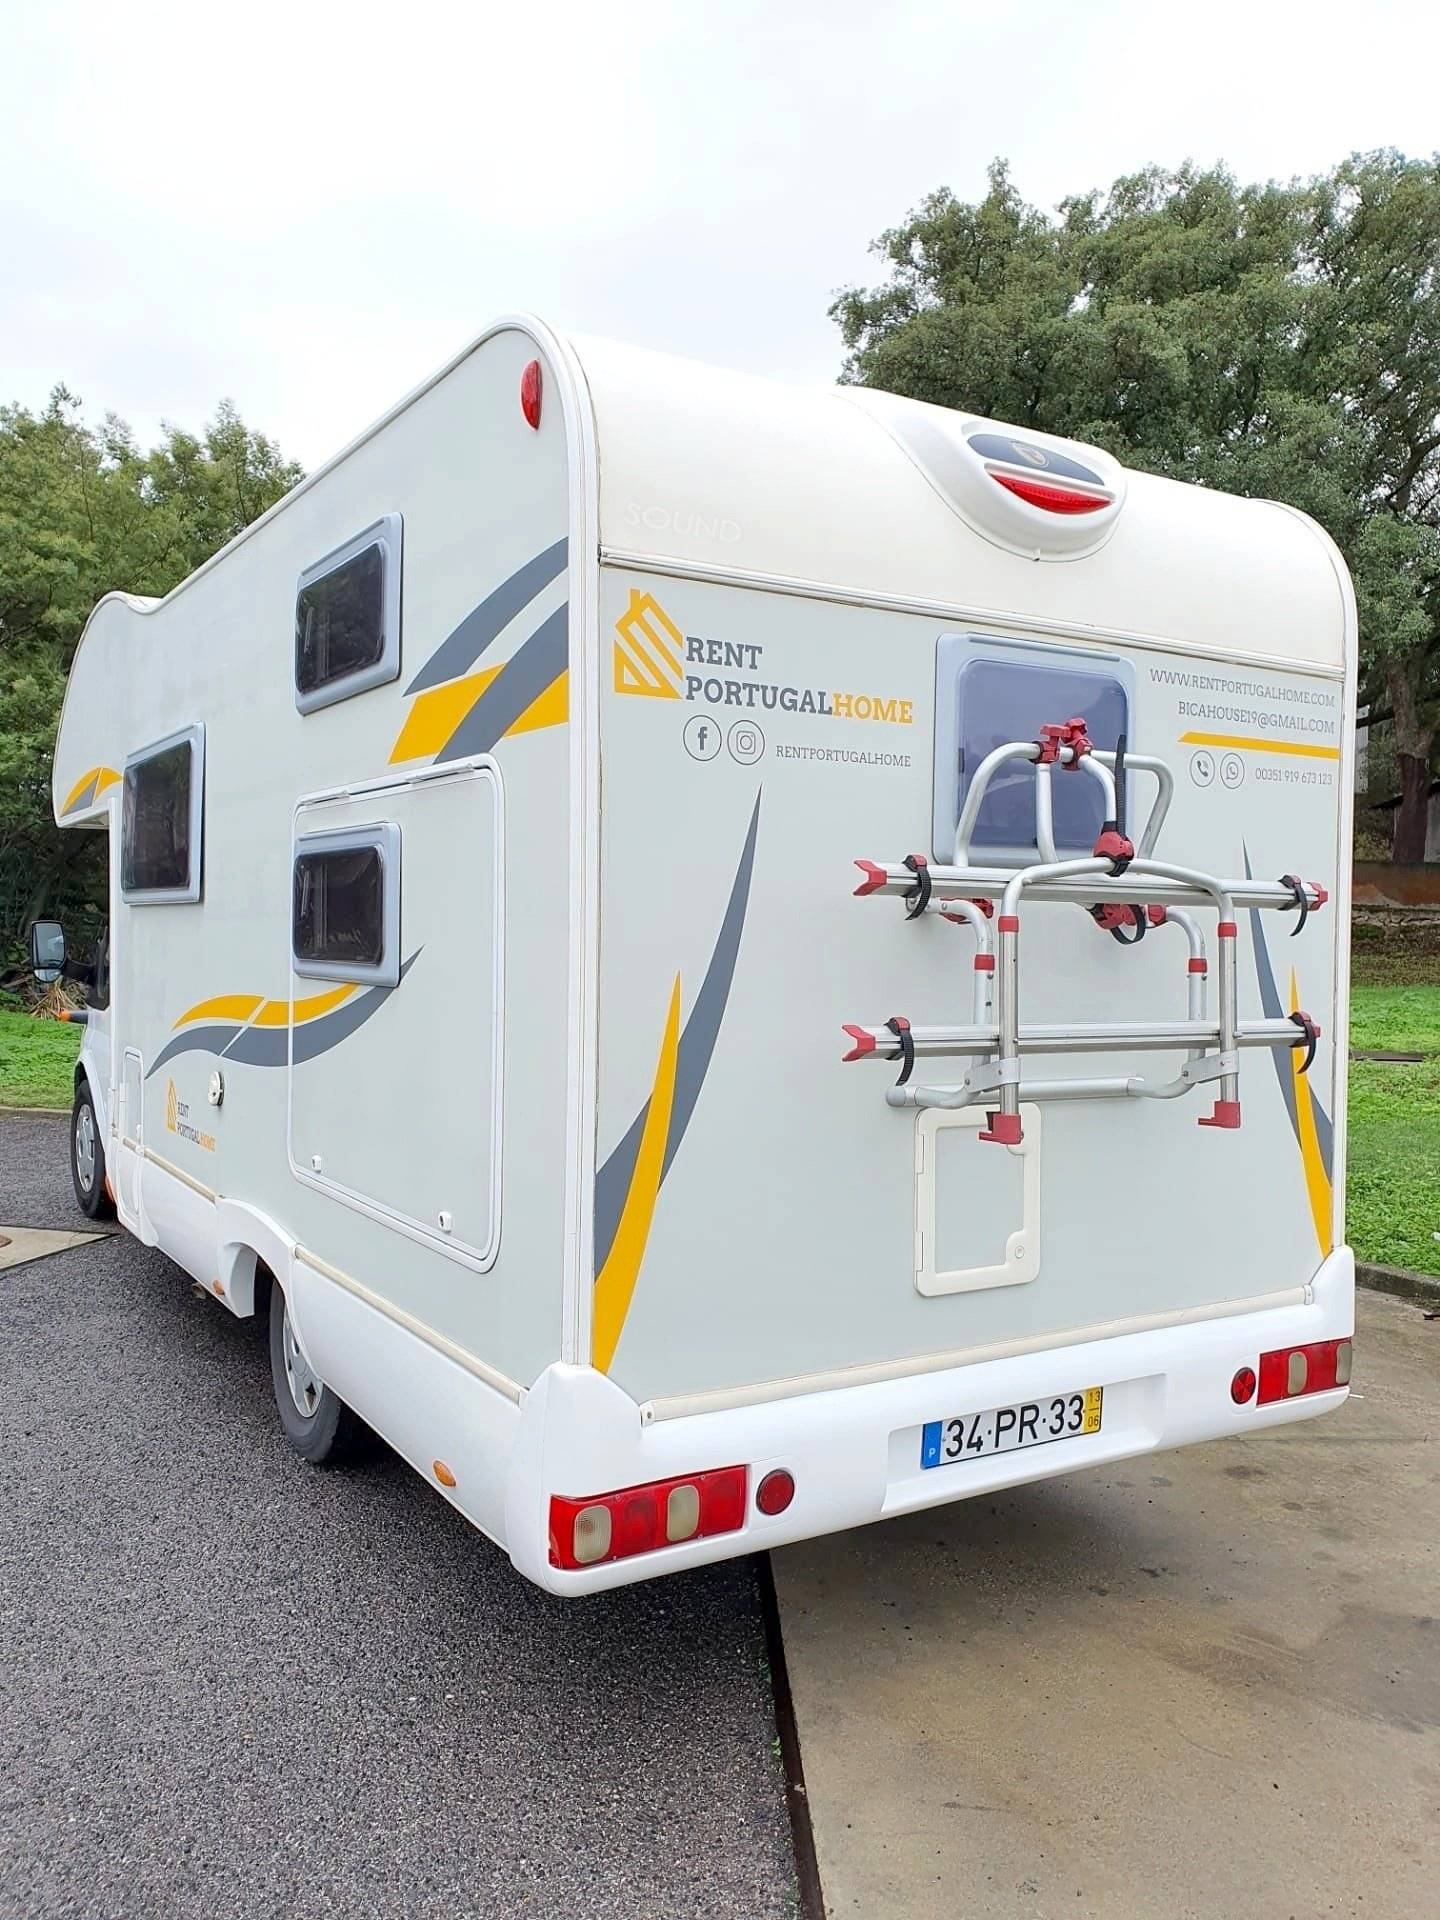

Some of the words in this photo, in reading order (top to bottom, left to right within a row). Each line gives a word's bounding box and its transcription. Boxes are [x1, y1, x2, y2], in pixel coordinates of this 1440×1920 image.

[624, 502, 742, 543] SOUND
[686, 636, 763, 670] RENT
[1150, 668, 1335, 708] WWW.RENTPORTUGALHOME.COM
[1178, 701, 1335, 733] BICAHOUSE19@GMAIL.COM
[776, 745, 911, 768] RENTPORTUGALHOME
[1255, 768, 1282, 782] 00351
[1284, 769, 1299, 783] 919
[1301, 771, 1317, 784] 673
[1318, 772, 1333, 785] 123
[1089, 1390, 1100, 1404] 13
[1087, 1414, 1099, 1428] 06
[928, 1448, 936, 1458] P
